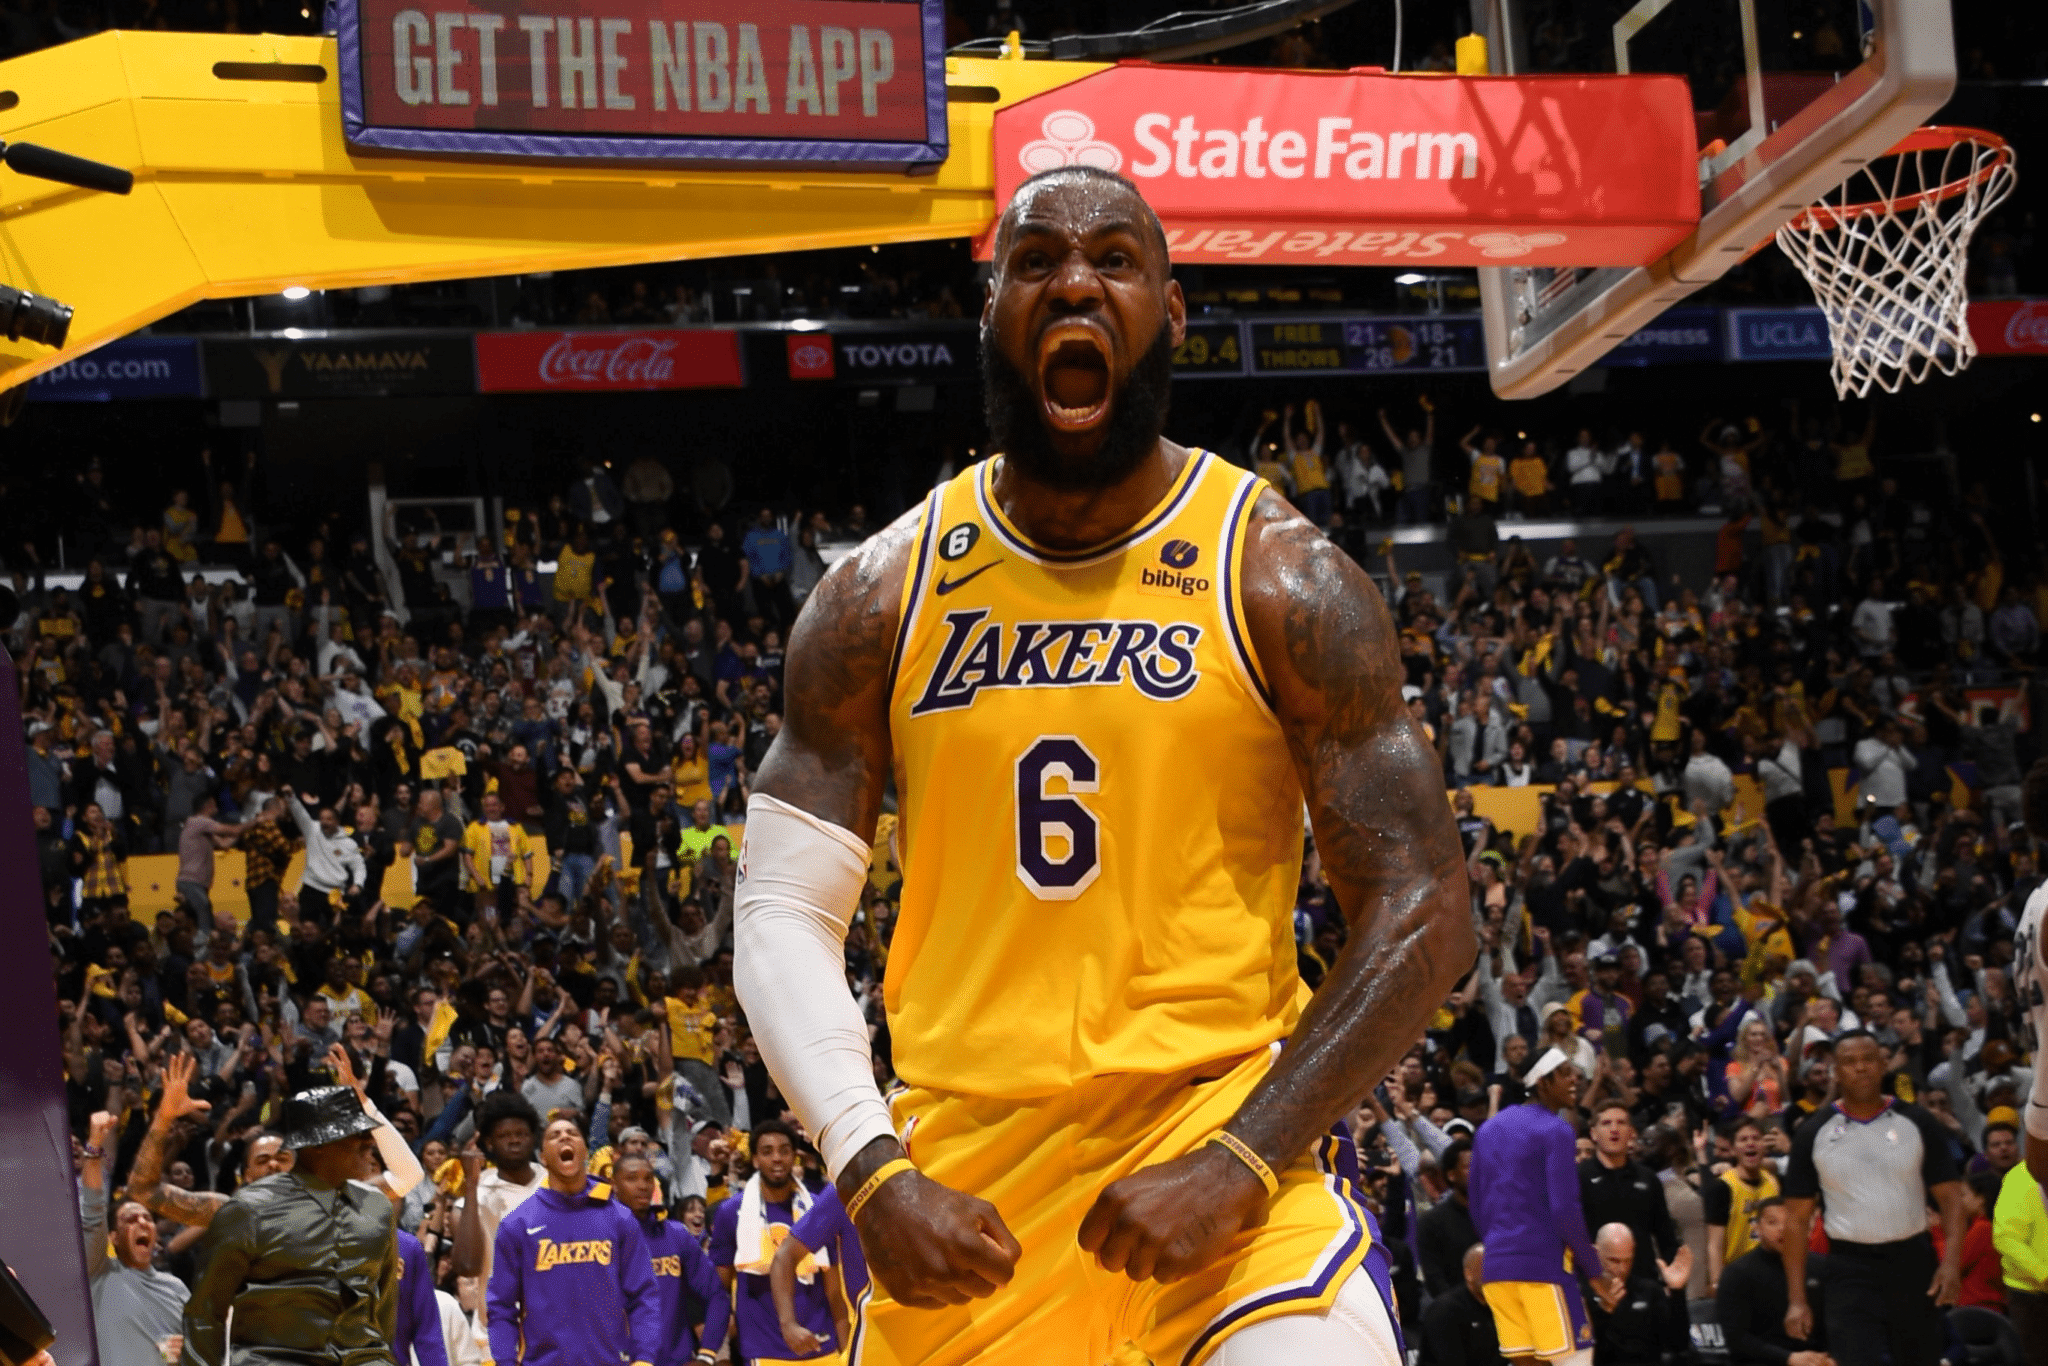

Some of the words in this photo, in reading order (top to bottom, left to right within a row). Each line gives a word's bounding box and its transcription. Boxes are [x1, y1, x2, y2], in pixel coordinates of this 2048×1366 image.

[393, 10, 504, 105] GET
[518, 15, 636, 110] THE
[648, 20, 771, 115] NBA
[785, 25, 894, 117] APP
[1273, 324, 1322, 343] FREE
[1751, 322, 1821, 346] UCLA
[842, 343, 953, 367] TOYOTA
[1260, 349, 1341, 368] THROWS
[948, 526, 970, 557] 6
[1142, 568, 1209, 596] bibigo
[910, 606, 1204, 719] LAKERS
[1014, 734, 1101, 901] 6
[1220, 1132, 1264, 1171] PROMISE
[535, 1238, 612, 1271] LAKERS
